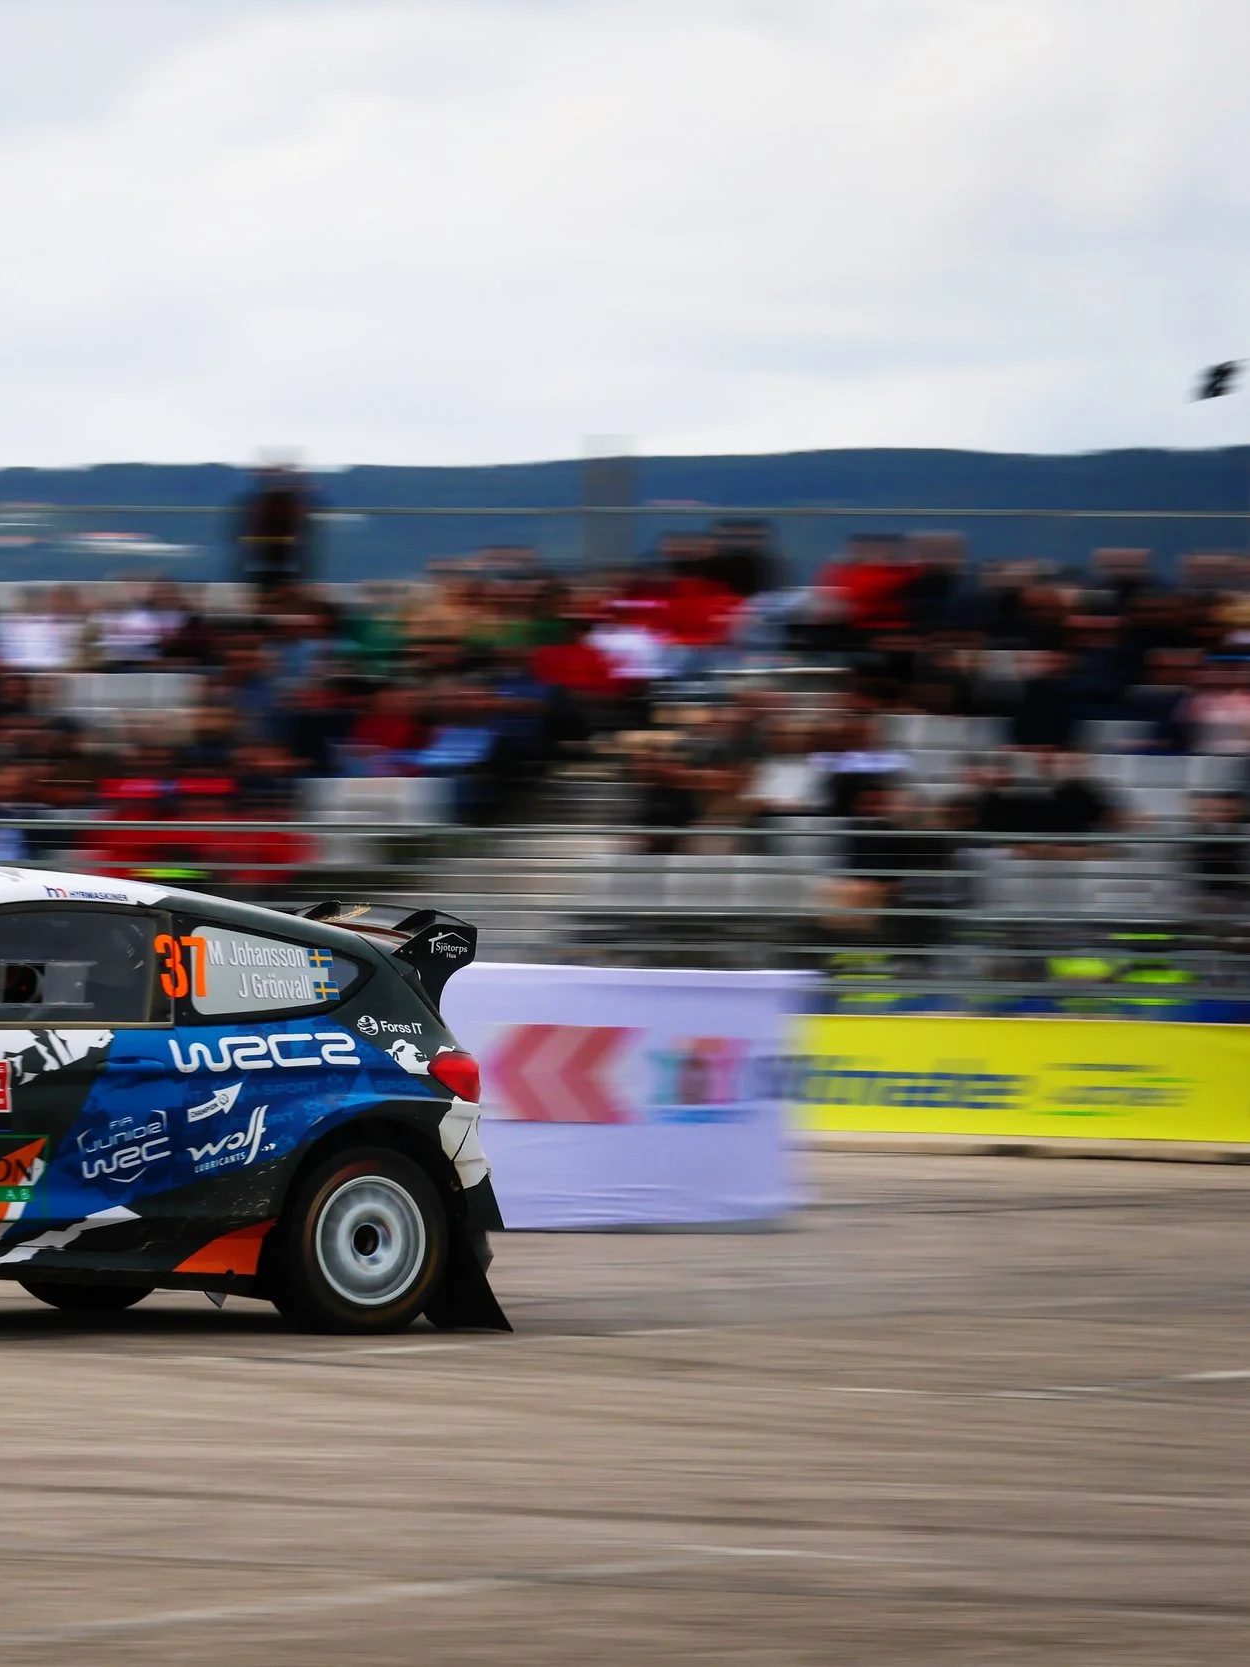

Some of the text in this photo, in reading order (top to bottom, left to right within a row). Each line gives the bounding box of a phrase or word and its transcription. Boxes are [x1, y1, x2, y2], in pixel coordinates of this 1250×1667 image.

[435, 942, 468, 955] Sjötorps
[154, 934, 306, 998] 37 M Johansson
[238, 973, 312, 1000] J Grönvall
[380, 1020, 423, 1035] Forss IT
[168, 1032, 361, 1074] WRC2
[190, 1103, 218, 1118] CHAMPION
[110, 1116, 134, 1130] FIA
[186, 1104, 269, 1166] wolf
[82, 1136, 172, 1179] WRC
[194, 1151, 246, 1173] LUBRICANTS
[5, 1189, 31, 1201] AB
